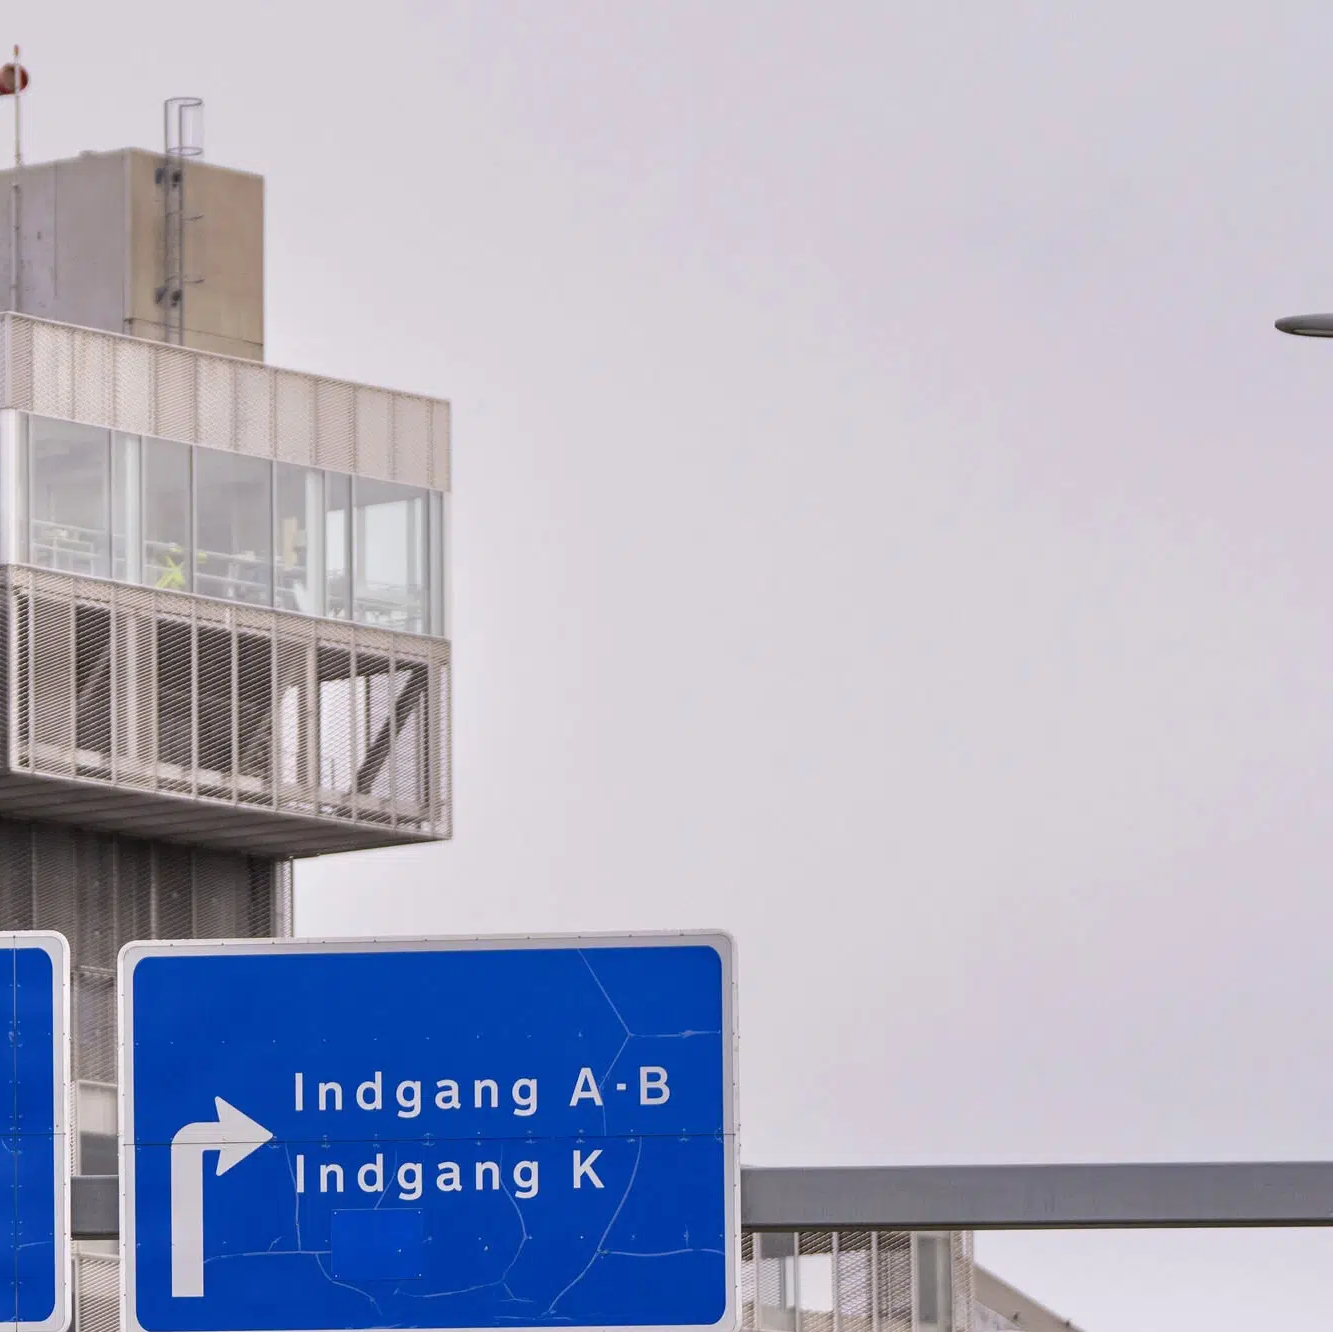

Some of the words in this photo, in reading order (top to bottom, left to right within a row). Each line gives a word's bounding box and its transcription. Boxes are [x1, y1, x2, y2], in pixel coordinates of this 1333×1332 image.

[294, 1070, 539, 1119] Indgang
[569, 1066, 671, 1108] A-B
[295, 1153, 540, 1201] Indgang
[572, 1148, 606, 1190] K
